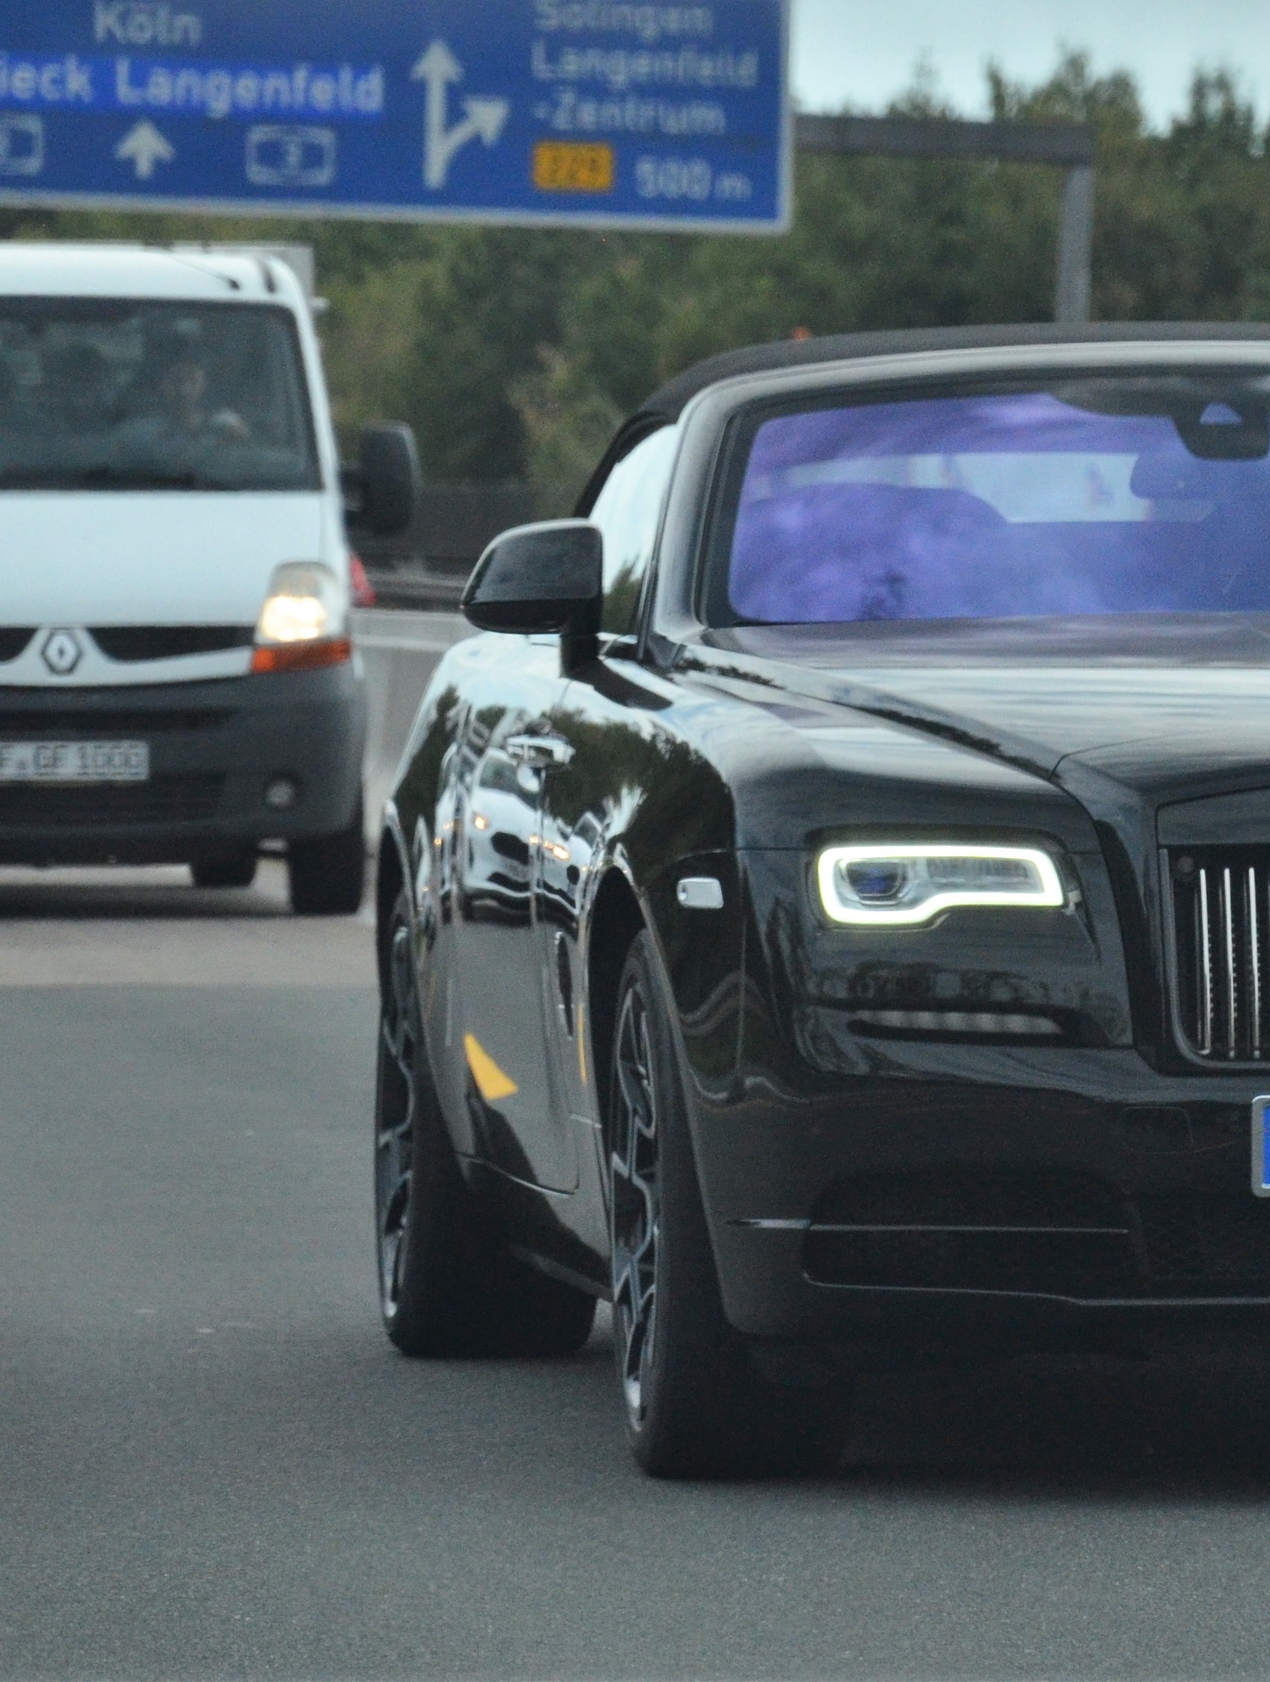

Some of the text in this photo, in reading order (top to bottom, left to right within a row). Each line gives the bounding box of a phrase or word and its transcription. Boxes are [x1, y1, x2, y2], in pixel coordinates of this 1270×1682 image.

[94, 2, 202, 45] Köln
[115, 54, 385, 119] Langenfeld
[531, 40, 760, 90] Langenfeld
[532, 86, 728, 136] -Zentrum
[634, 155, 754, 202] 500 m
